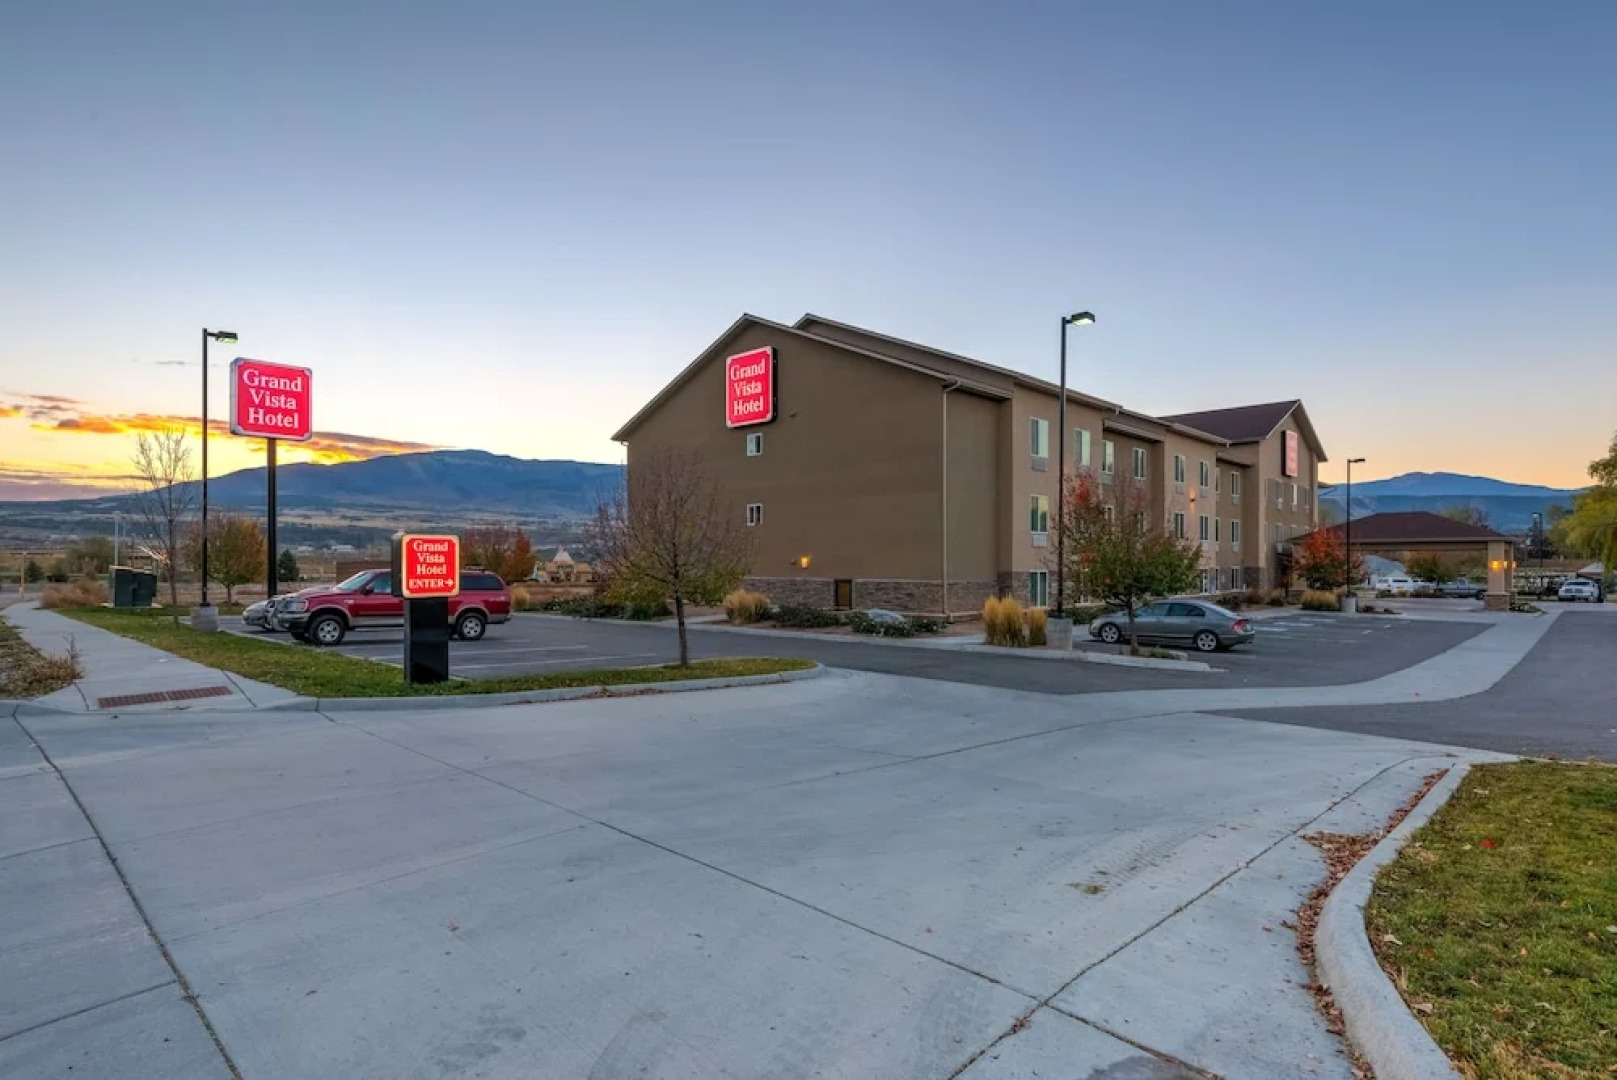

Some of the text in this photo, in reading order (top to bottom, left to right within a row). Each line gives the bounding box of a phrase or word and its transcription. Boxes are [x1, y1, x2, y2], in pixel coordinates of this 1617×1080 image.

[731, 359, 765, 380] Grand
[242, 368, 302, 392] Grand
[734, 380, 762, 396] Vista
[249, 388, 296, 409] Vista
[734, 396, 763, 415] Hotel
[248, 407, 298, 428] Hotel
[413, 540, 448, 551] Grand
[416, 552, 446, 563] Vista
[416, 563, 447, 575] Hotel
[408, 578, 444, 589] ENTER
